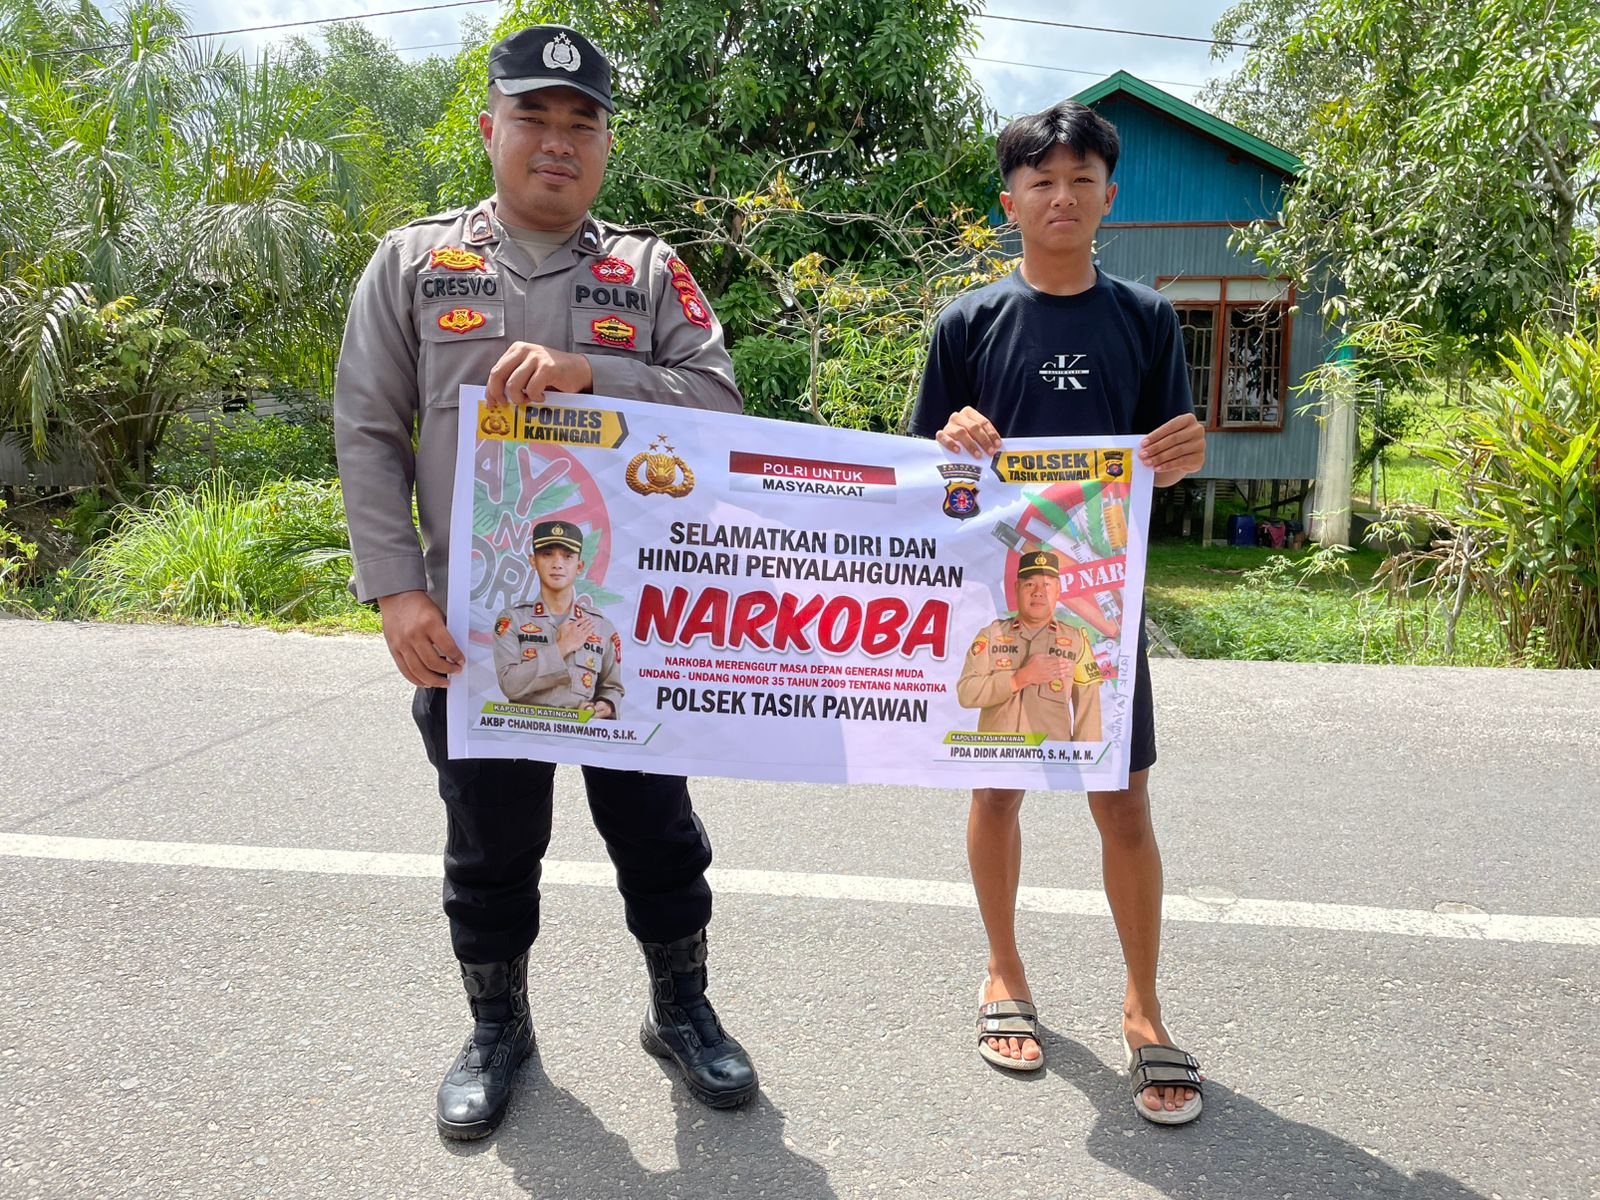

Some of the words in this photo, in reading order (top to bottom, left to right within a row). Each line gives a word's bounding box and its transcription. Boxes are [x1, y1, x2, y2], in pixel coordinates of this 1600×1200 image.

[422, 275, 497, 298] CRESVO
[575, 284, 646, 311] POLRI
[524, 406, 602, 429] POLRES
[524, 426, 601, 444] KATINGAN
[763, 462, 808, 477] POLRI
[812, 467, 863, 482] UNTUK
[1007, 453, 1089, 470] POLSEK
[1008, 470, 1038, 481] TASIK
[1040, 470, 1090, 481] PAYAWAN
[762, 478, 865, 497] MASYARAKAT
[669, 521, 826, 553] SELAMATKAN
[834, 533, 881, 557] DIRI
[889, 536, 936, 559] DAN
[638, 548, 738, 576] HINDARI
[745, 555, 964, 588] PENYALAHGUNAAN
[1077, 562, 1126, 589] NAR
[634, 583, 950, 658] NARKOBA
[583, 642, 604, 655] OLRI
[992, 645, 1019, 654] DIDIK
[1048, 647, 1076, 660] POLRI
[664, 656, 713, 669] NARKOBA
[715, 659, 778, 673] MERENGGUT
[779, 662, 808, 674] MASA
[810, 664, 843, 676] DEPAN
[845, 666, 893, 678] GENERASI
[895, 668, 924, 679] MUDA
[638, 669, 680, 680] UNDANG
[688, 672, 730, 684] UNDANG
[732, 674, 769, 686] NOMOR
[771, 676, 784, 686] 35
[786, 676, 819, 687] TAHUN
[820, 678, 846, 689] 2009
[848, 679, 891, 691] TENTANG
[893, 681, 947, 693] NARKOTIKA
[493, 704, 535, 715] KAPOLRES
[537, 708, 579, 719] KATINGAN
[656, 687, 747, 715] POLSEK
[751, 692, 819, 718] TASIK
[822, 696, 928, 723] PAYAWAN
[480, 716, 505, 727] AKBP
[507, 719, 551, 732] CHANDRA
[553, 723, 611, 740] ISMAWANTO,
[612, 729, 637, 741] S.I.K.
[952, 734, 983, 742] KAPOLSEK
[999, 735, 1025, 743] PAYAWAN
[950, 747, 972, 758] IPDA
[973, 747, 997, 759] DIDIK
[999, 748, 1046, 761] ARIYANTO,
[1048, 749, 1057, 760] S.
[1072, 750, 1083, 760] M.
[1083, 750, 1094, 761] M.
